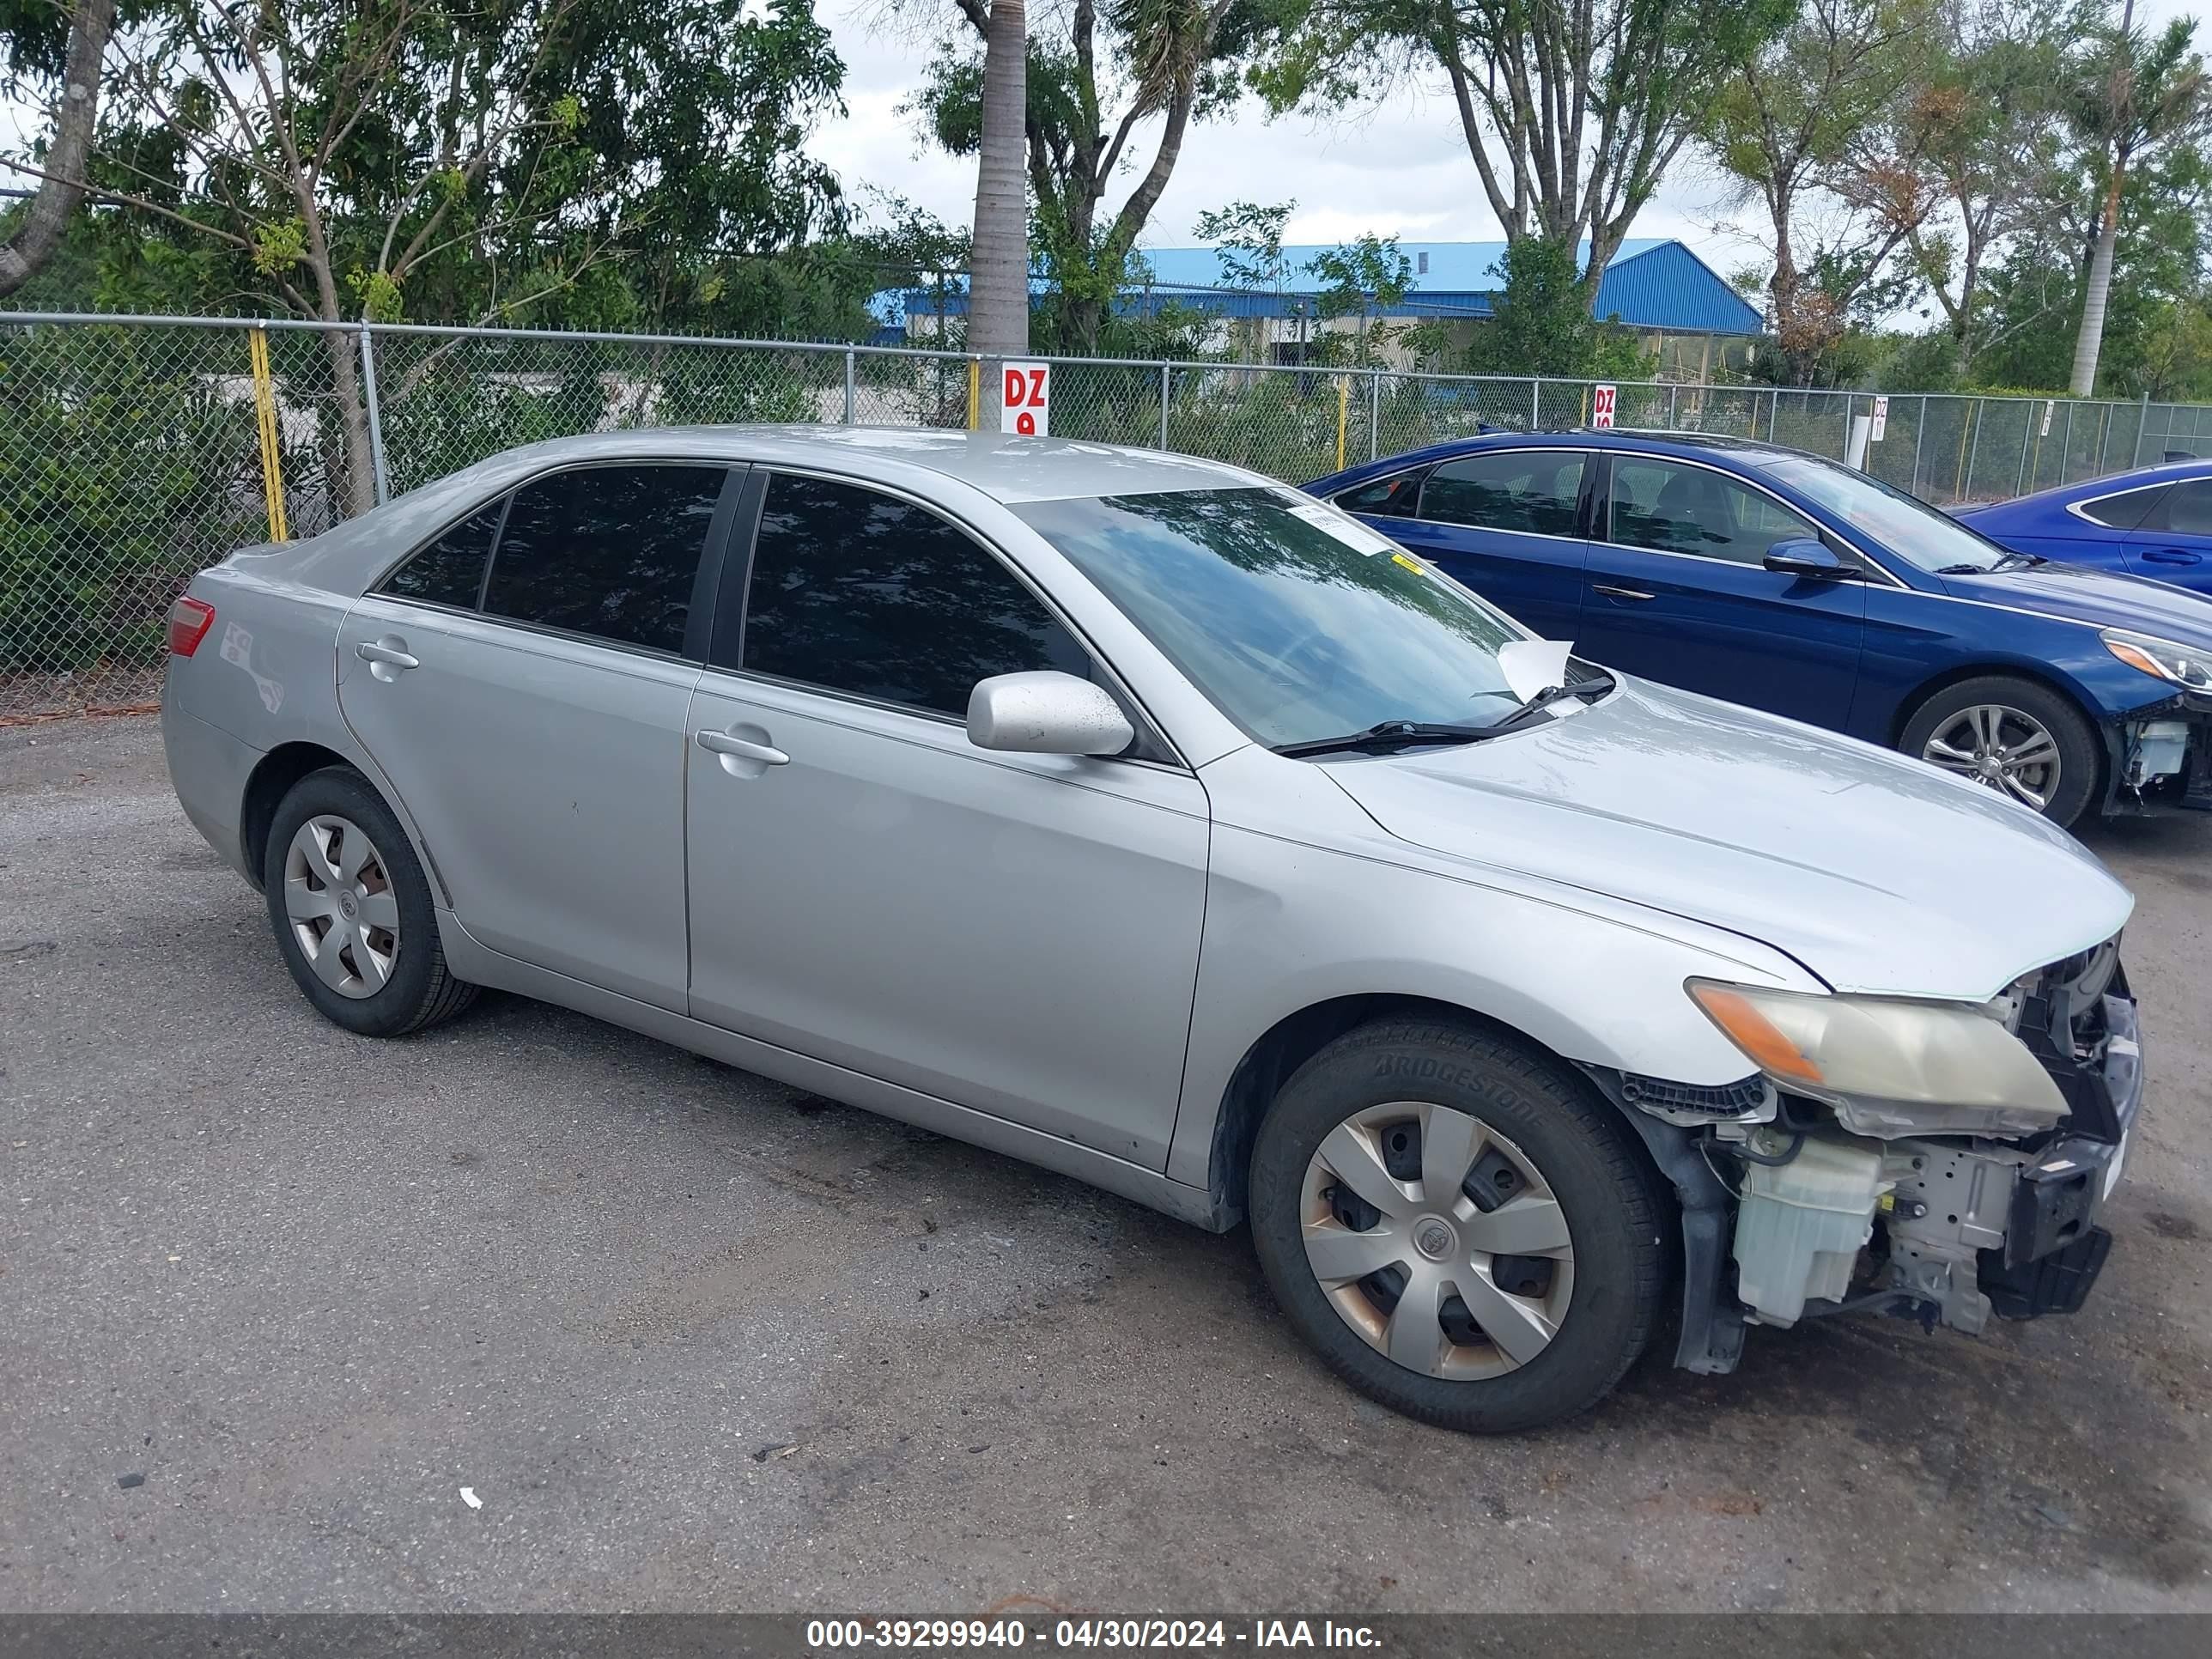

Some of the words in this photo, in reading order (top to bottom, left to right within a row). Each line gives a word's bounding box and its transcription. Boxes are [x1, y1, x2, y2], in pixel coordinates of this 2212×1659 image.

[1005, 369, 1047, 407] DZ
[1595, 389, 1614, 413] DZ
[1875, 400, 1887, 417] DZ
[1017, 412, 1035, 435] 9
[1875, 420, 1881, 438] 11
